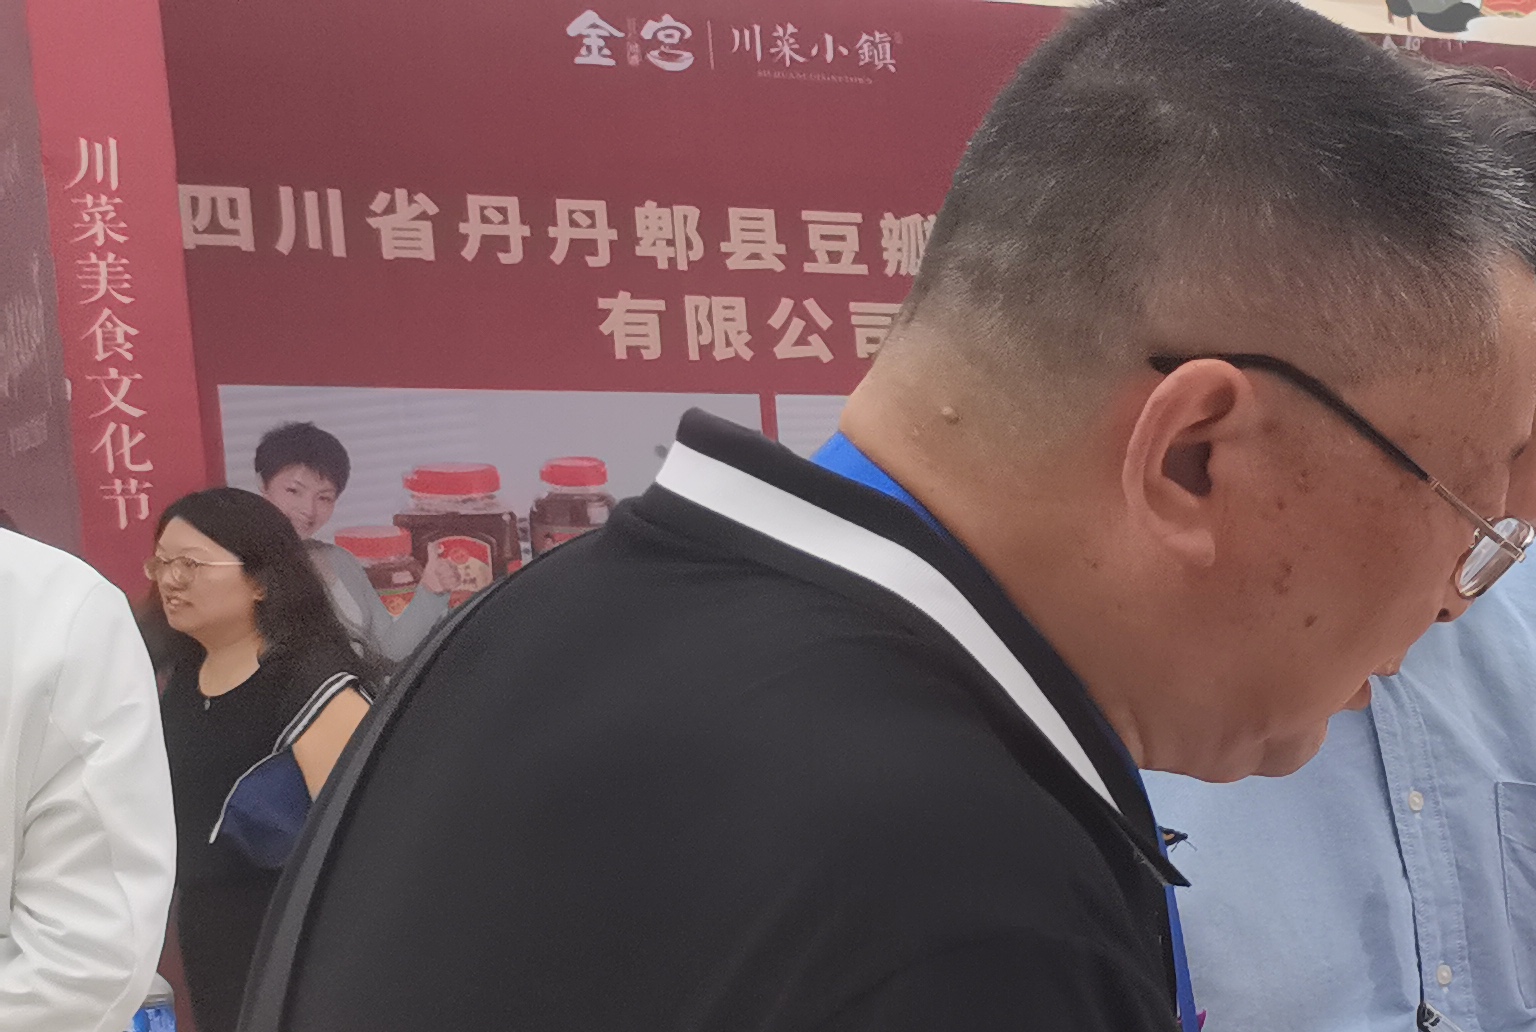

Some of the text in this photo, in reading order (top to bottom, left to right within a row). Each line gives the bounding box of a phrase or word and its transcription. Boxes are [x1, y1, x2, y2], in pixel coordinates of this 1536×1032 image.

[64, 135, 155, 531] 川菜美食文化节
